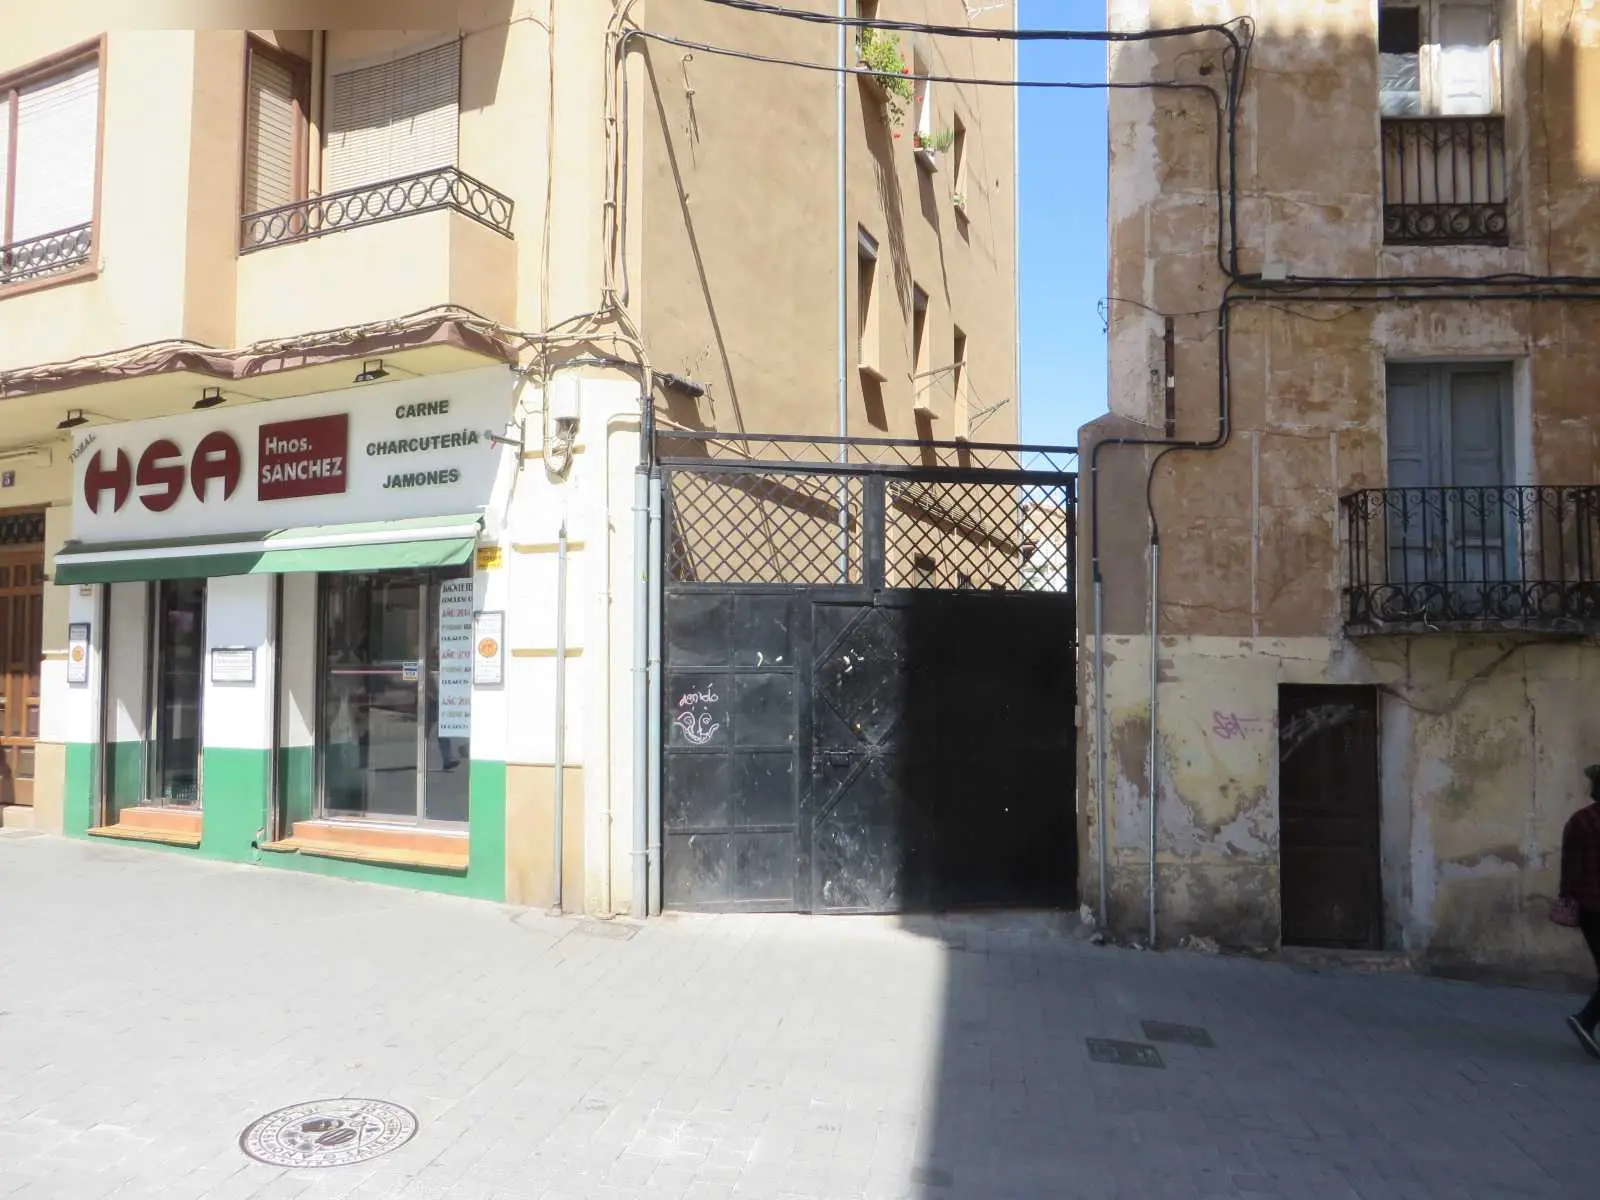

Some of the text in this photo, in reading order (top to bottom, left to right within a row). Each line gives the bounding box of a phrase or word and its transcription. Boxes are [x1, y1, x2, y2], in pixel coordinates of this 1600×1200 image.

[395, 400, 450, 419] CARNE
[366, 428, 479, 457] CHARCUTERÍA
[84, 430, 242, 515] HSA
[382, 469, 460, 489] JAMONES
